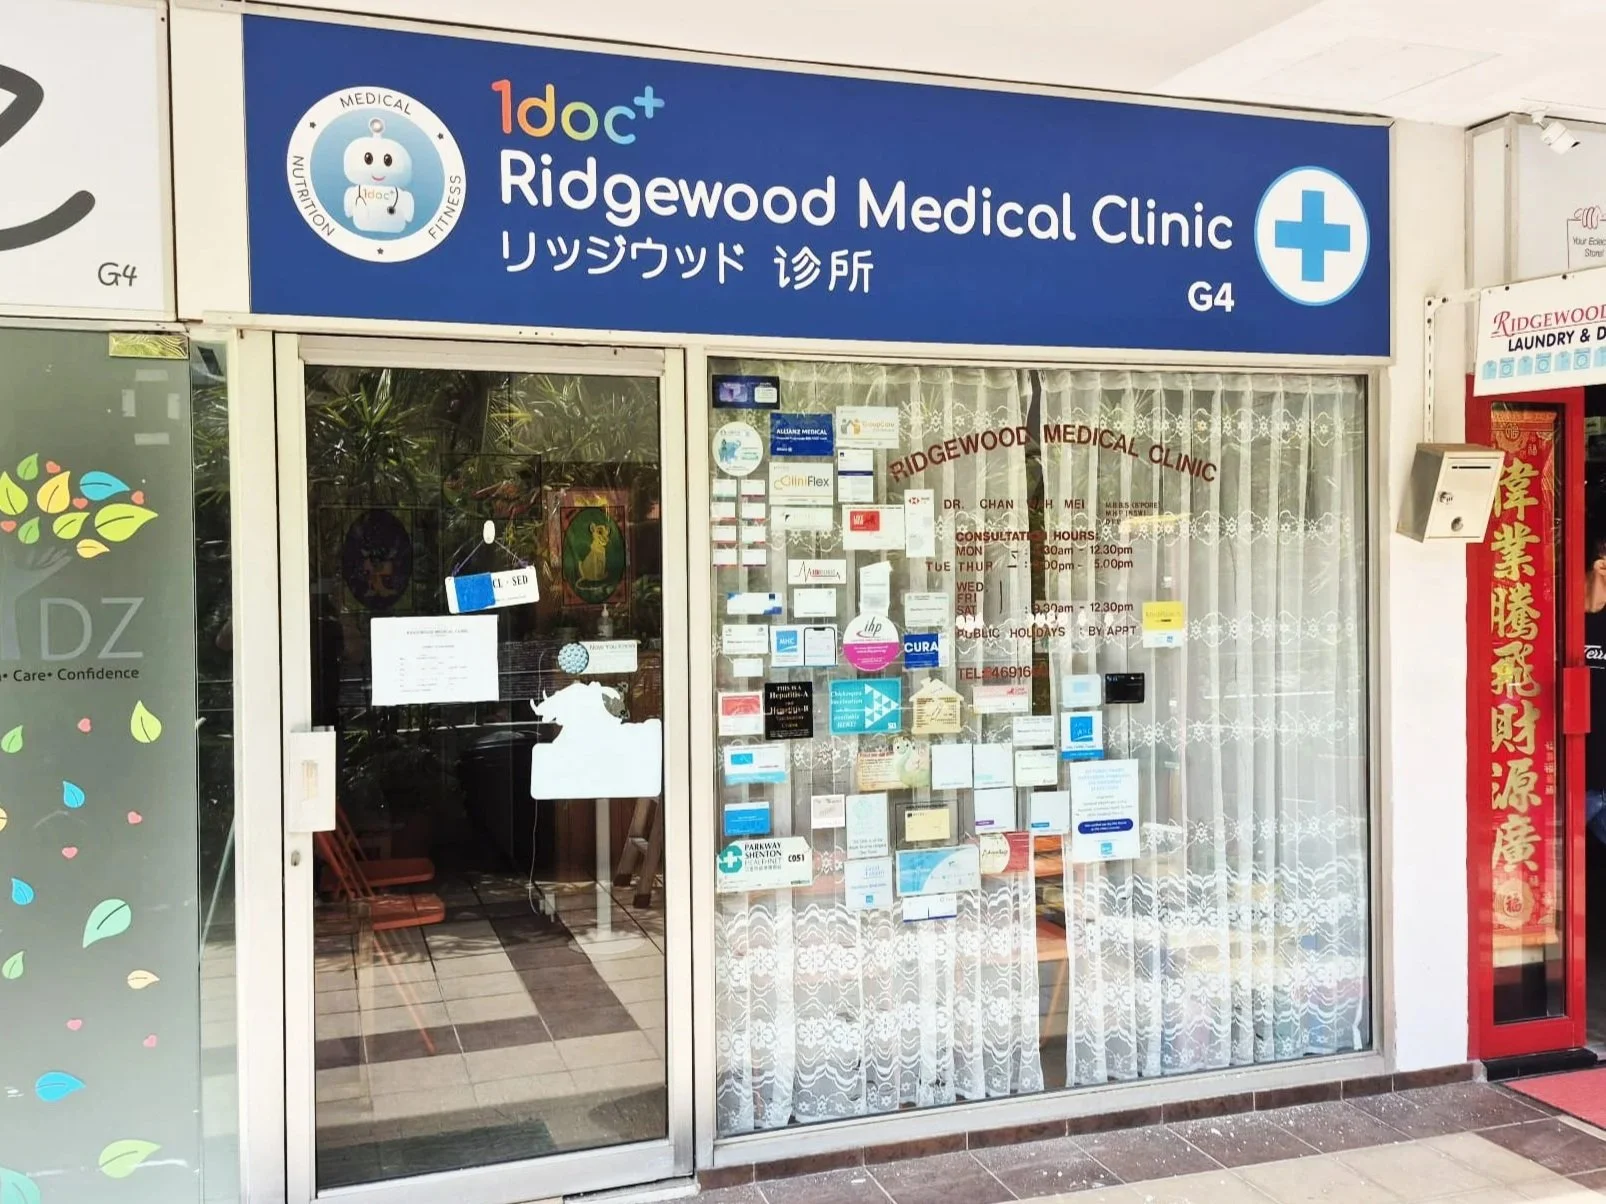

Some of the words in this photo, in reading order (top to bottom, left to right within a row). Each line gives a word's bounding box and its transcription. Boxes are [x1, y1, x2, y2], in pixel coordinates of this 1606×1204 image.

[339, 92, 412, 115] MEDICAL
[292, 155, 335, 236] NUTRITION
[500, 149, 836, 227] Ridgewood
[859, 177, 1077, 241] Medical
[1092, 194, 1233, 250] Clinic
[428, 175, 461, 240] FITNESS
[502, 230, 744, 285] リッジウッド
[773, 245, 874, 293] 诊所
[97, 262, 138, 287] G4
[1187, 281, 1235, 313] G4
[1508, 330, 1575, 352] LAUNDRY
[1580, 328, 1591, 343] &
[889, 425, 1030, 483] RIDGEWOOD
[1043, 424, 1139, 458] MEDICAL
[1148, 444, 1218, 482] CLINIC
[943, 500, 964, 510] DR.
[979, 499, 1014, 510] CHAN
[1064, 499, 1085, 510] MEI
[956, 546, 983, 556] MON
[1090, 545, 1133, 557] 12.30pm
[925, 561, 951, 572] TUE
[958, 561, 993, 572] THUR
[492, 574, 529, 589] CLSED
[957, 593, 977, 603] FRI
[1033, 603, 1074, 613] 9.30am
[1090, 602, 1134, 614] 12.30pm
[957, 628, 1000, 639] PUBLIC
[1010, 627, 1066, 638] HOLIDAYS
[1088, 627, 1101, 637] BY
[1107, 626, 1137, 636] APPT
[904, 641, 939, 653] CURA
[57, 667, 140, 681] Confidence
[744, 842, 781, 850] PARKWAY
[744, 850, 782, 858] SHENTON
